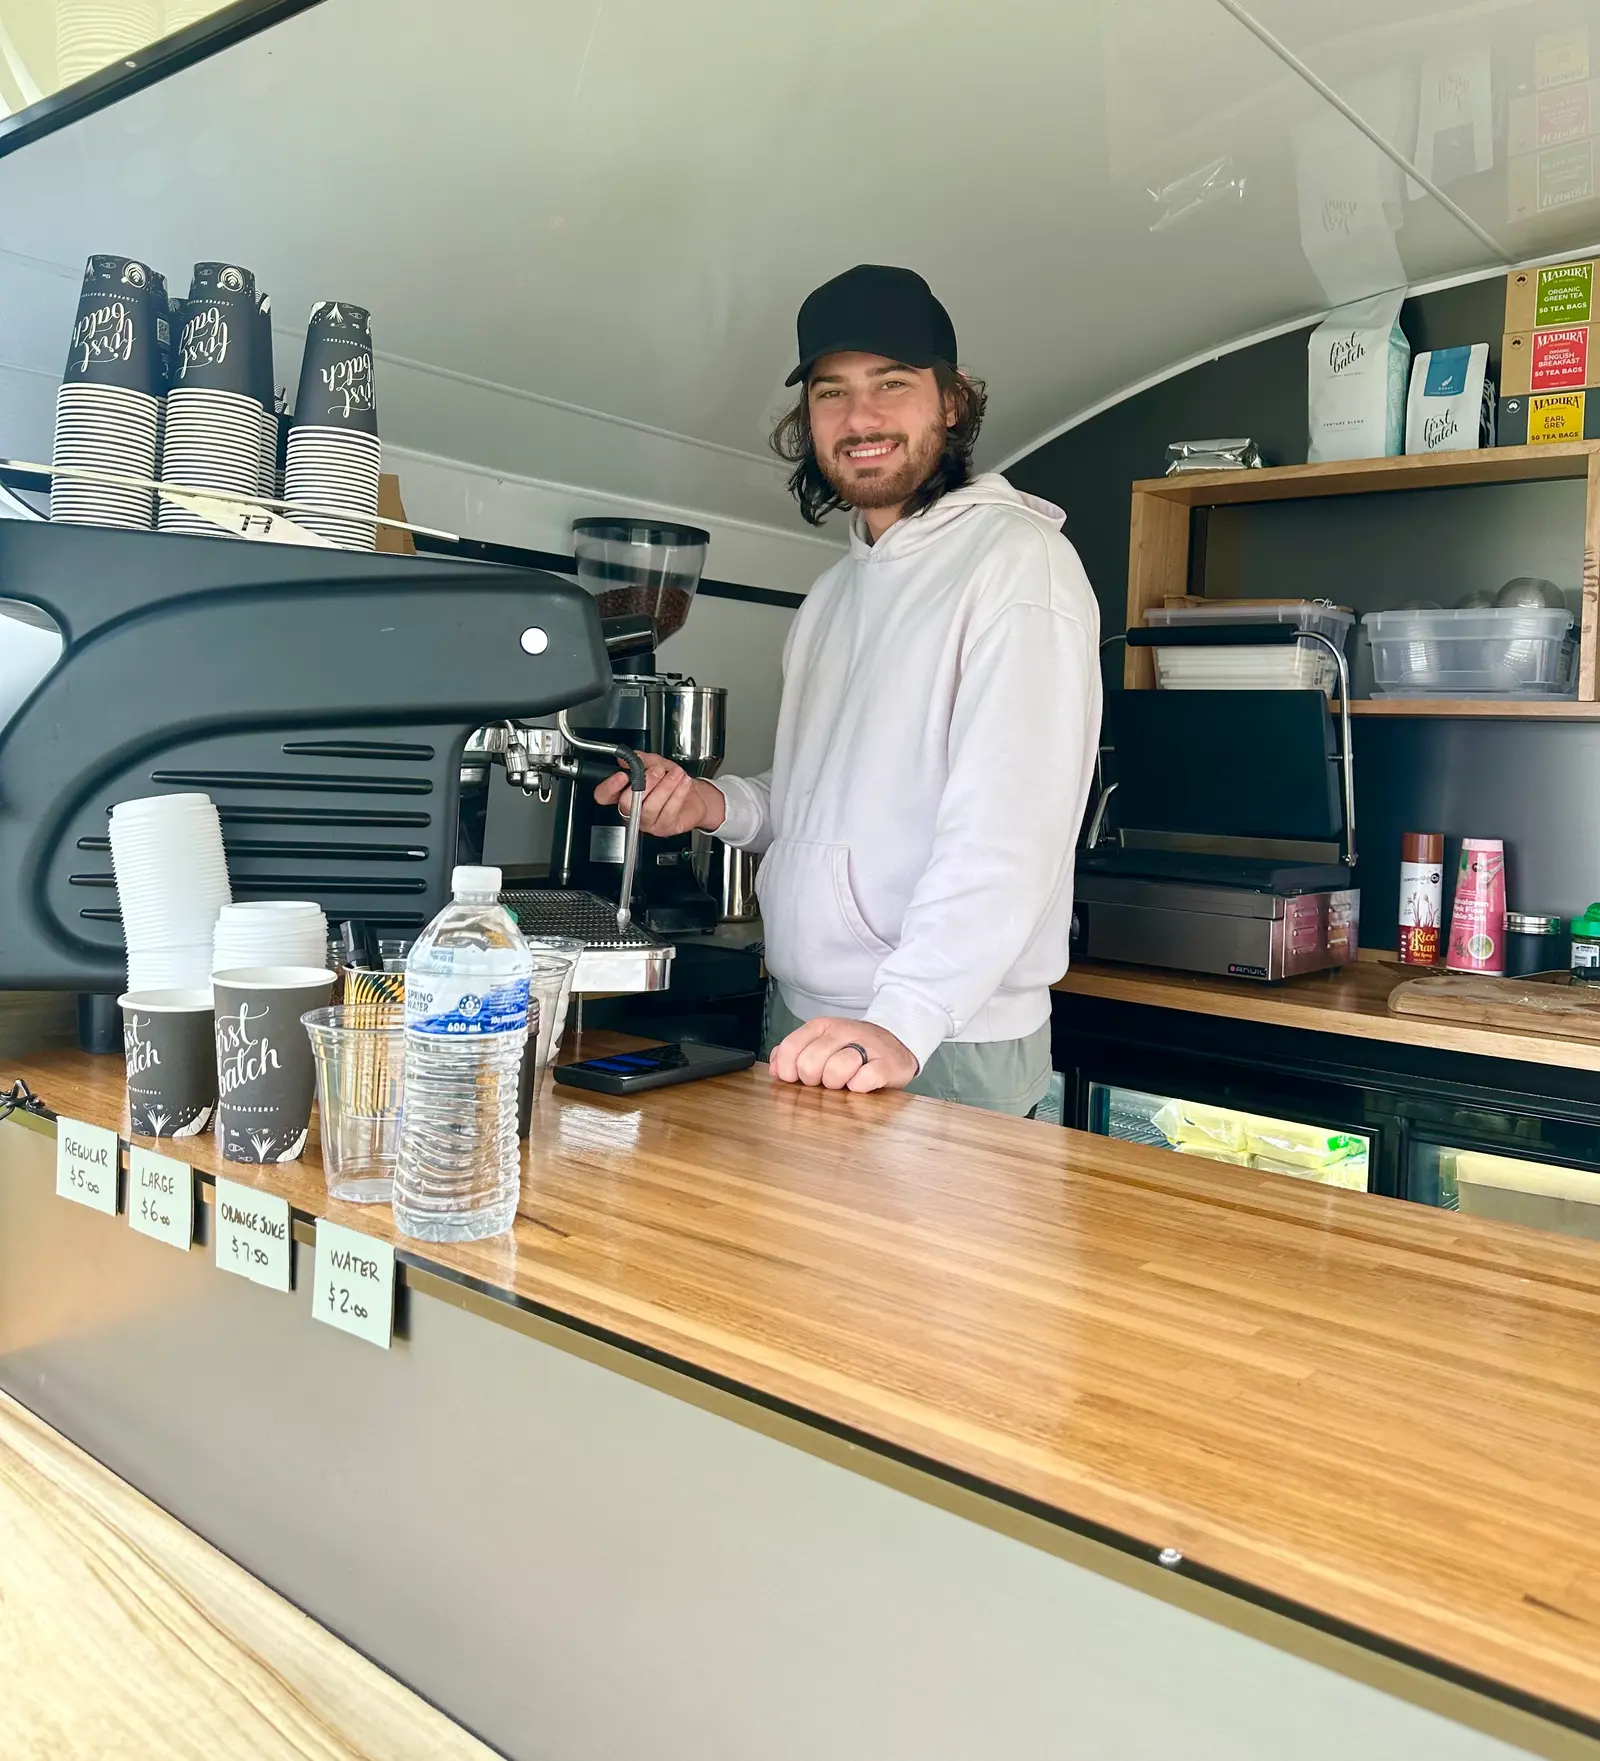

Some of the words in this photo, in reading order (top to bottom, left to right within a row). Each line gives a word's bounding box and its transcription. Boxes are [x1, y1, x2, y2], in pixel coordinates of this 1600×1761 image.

[1541, 266, 1588, 286] MADURA
[1544, 294, 1568, 302] GREEN
[1548, 286, 1580, 296] ORGANIC
[1539, 306, 1548, 314] 50
[1566, 302, 1588, 310] BAGS
[70, 318, 136, 372] first
[1329, 331, 1360, 366] first
[1536, 331, 1584, 349] MADURA
[176, 322, 232, 379] first
[1334, 344, 1366, 373] batch
[1544, 352, 1574, 361] ENGLISH
[1538, 357, 1580, 368] BREAKFAST
[1562, 366, 1582, 374] BAGS
[320, 353, 371, 392] batch
[1533, 396, 1580, 413] MADURA
[1424, 409, 1455, 442] first
[1428, 420, 1458, 449] batch
[1410, 936, 1436, 952] Bran
[1414, 928, 1436, 943] Rice
[408, 989, 434, 1004] SPRING
[408, 1000, 429, 1013] WATER
[448, 1022, 466, 1032] 600
[468, 1022, 482, 1032] mL
[232, 1104, 274, 1112] ROASTERS
[65, 1137, 108, 1168] REGULAR
[70, 1165, 100, 1194] $5.00
[142, 1167, 174, 1194] LARGE
[222, 1203, 258, 1231] ORANGE
[330, 1250, 380, 1282] WATER
[328, 1282, 368, 1318] $2.00
